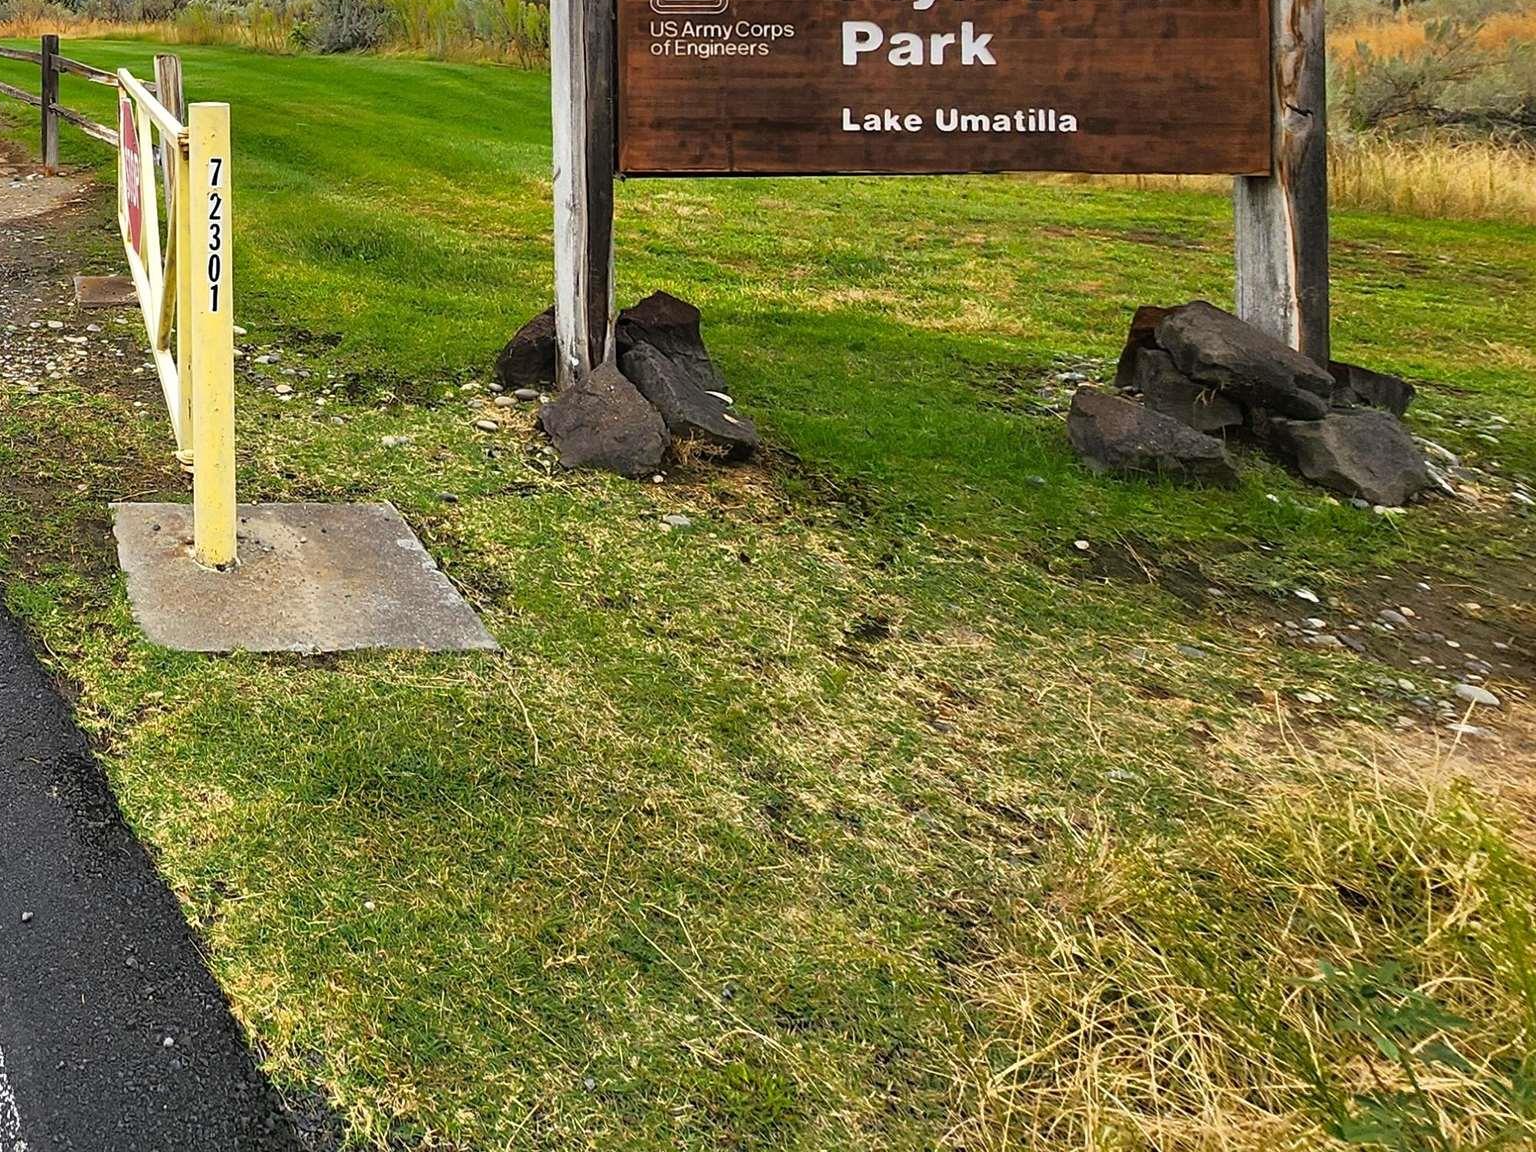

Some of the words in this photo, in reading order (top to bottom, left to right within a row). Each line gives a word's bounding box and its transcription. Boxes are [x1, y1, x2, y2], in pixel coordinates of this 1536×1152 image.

[650, 21, 678, 38] US
[681, 21, 733, 40] Army
[735, 21, 795, 41] Corps
[841, 21, 997, 66] Park
[650, 39, 671, 56] of
[675, 39, 770, 59] Engineers
[842, 107, 923, 132] Lake
[935, 107, 1078, 132] Umatilla
[208, 158, 222, 312] 72301
